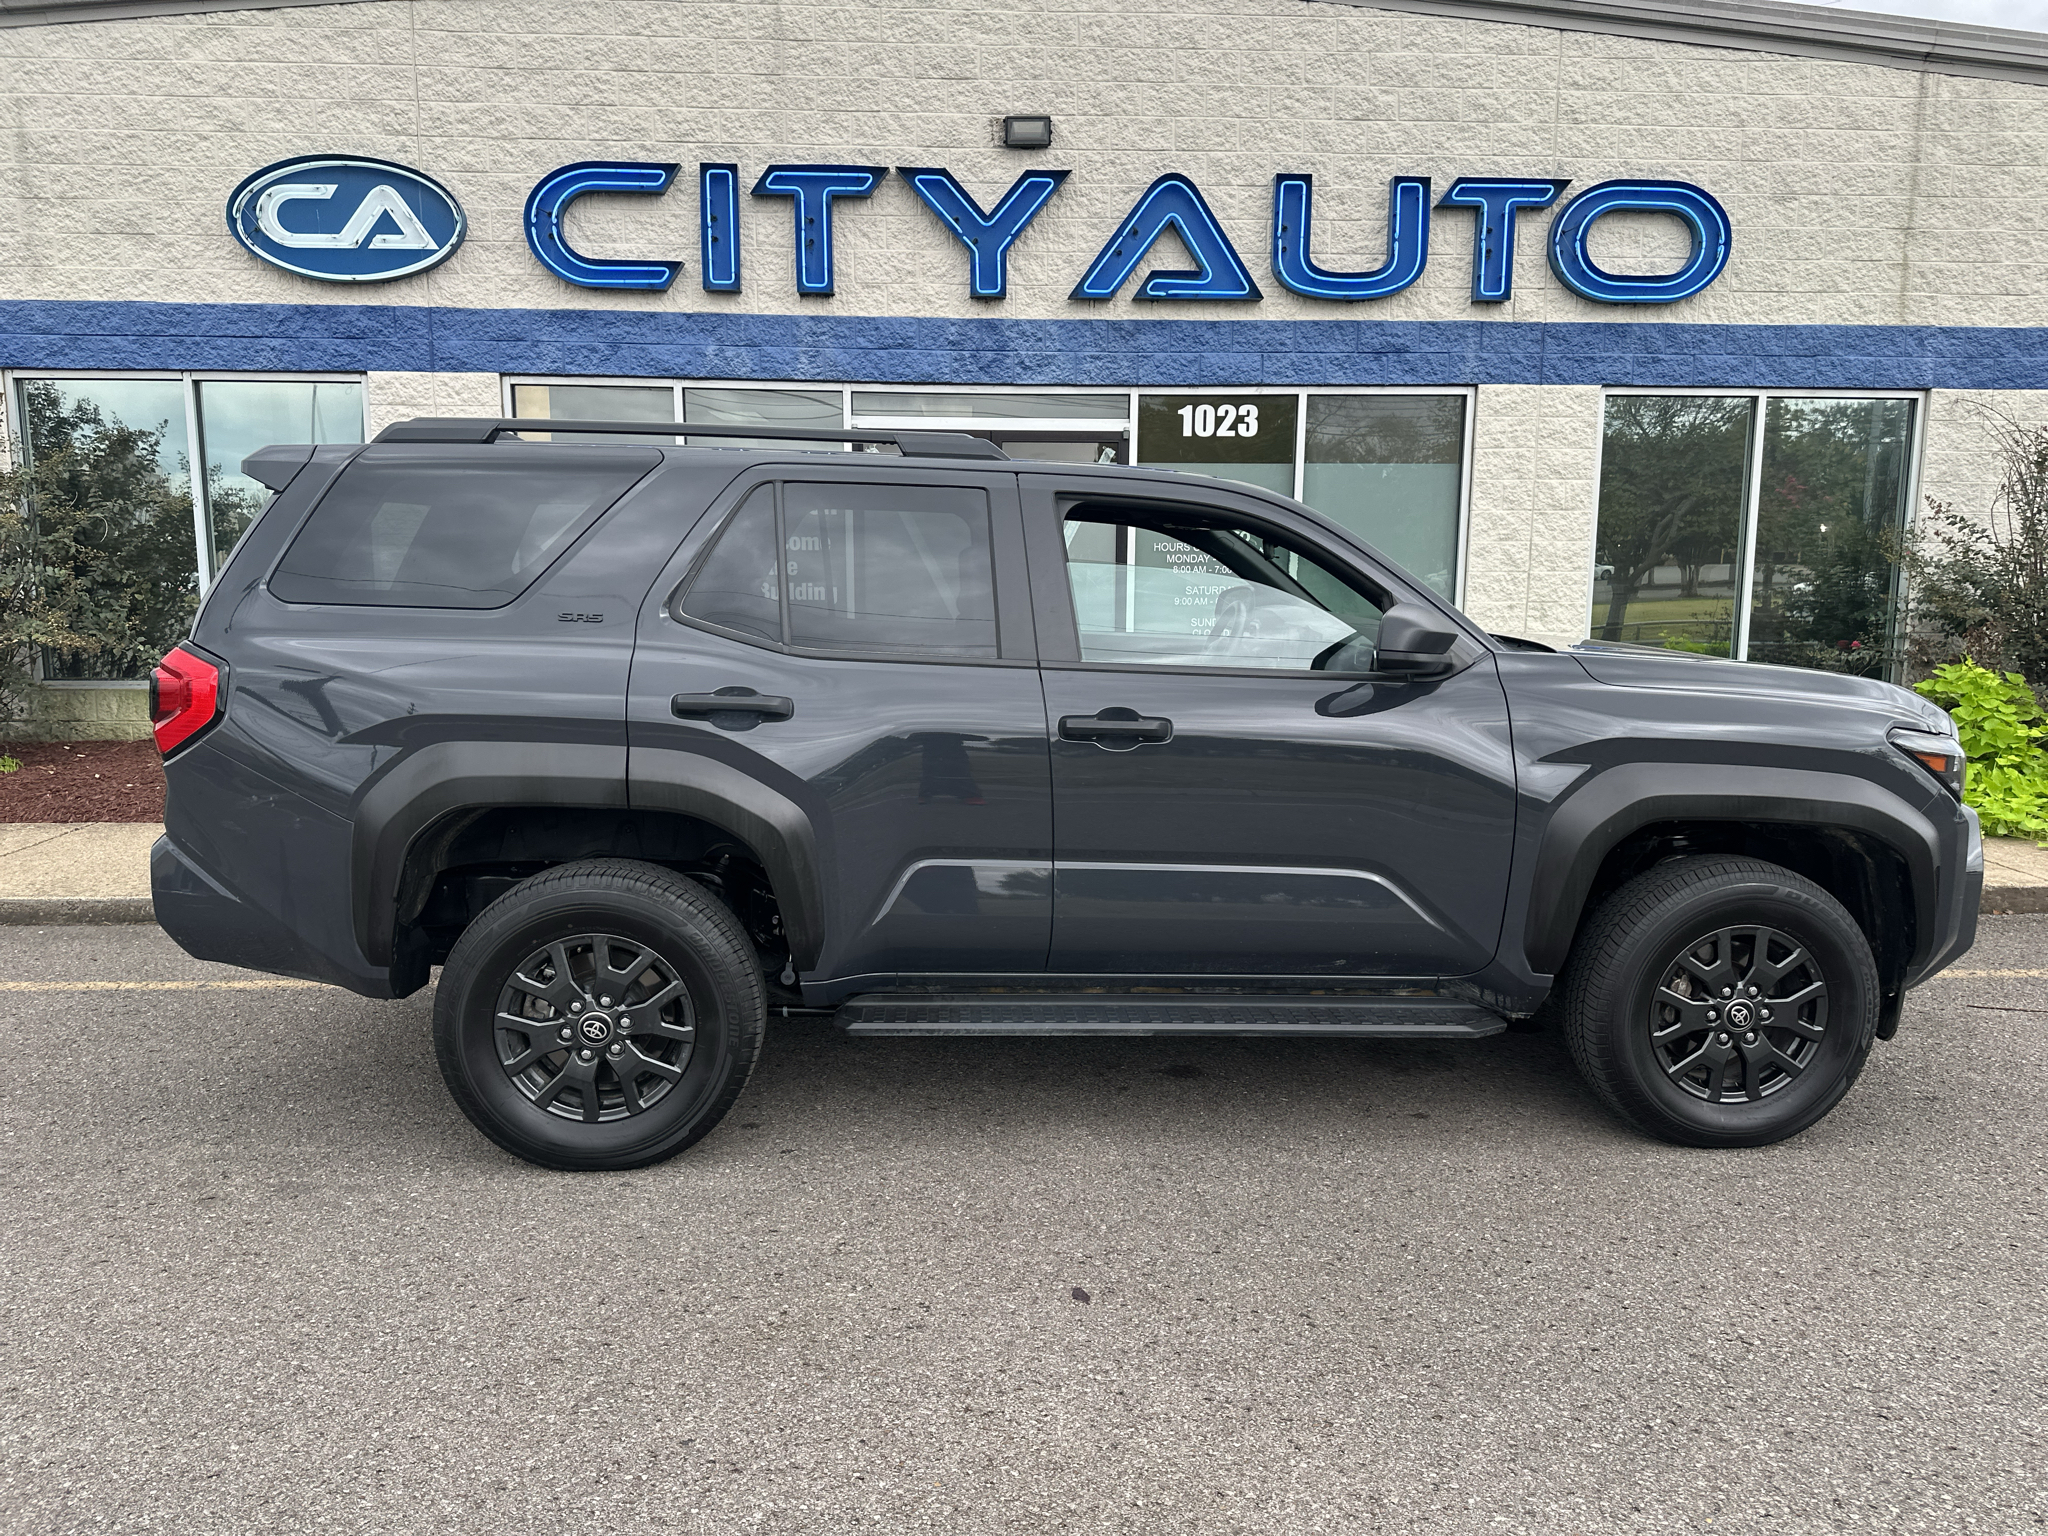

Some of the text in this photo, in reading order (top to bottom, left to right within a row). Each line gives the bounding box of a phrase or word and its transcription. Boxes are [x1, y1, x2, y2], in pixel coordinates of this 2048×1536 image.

[256, 183, 439, 251] CA
[524, 160, 1732, 304] CITY AUTO
[1178, 403, 1259, 438] 1023
[1153, 542, 1190, 552] HOURS
[1166, 554, 1210, 563] MONDAY
[1172, 565, 1192, 574] 8:00
[1192, 565, 1207, 574] AM
[1185, 585, 1235, 595] SATURD
[1174, 597, 1193, 606] 9:00
[1193, 597, 1208, 606] AM
